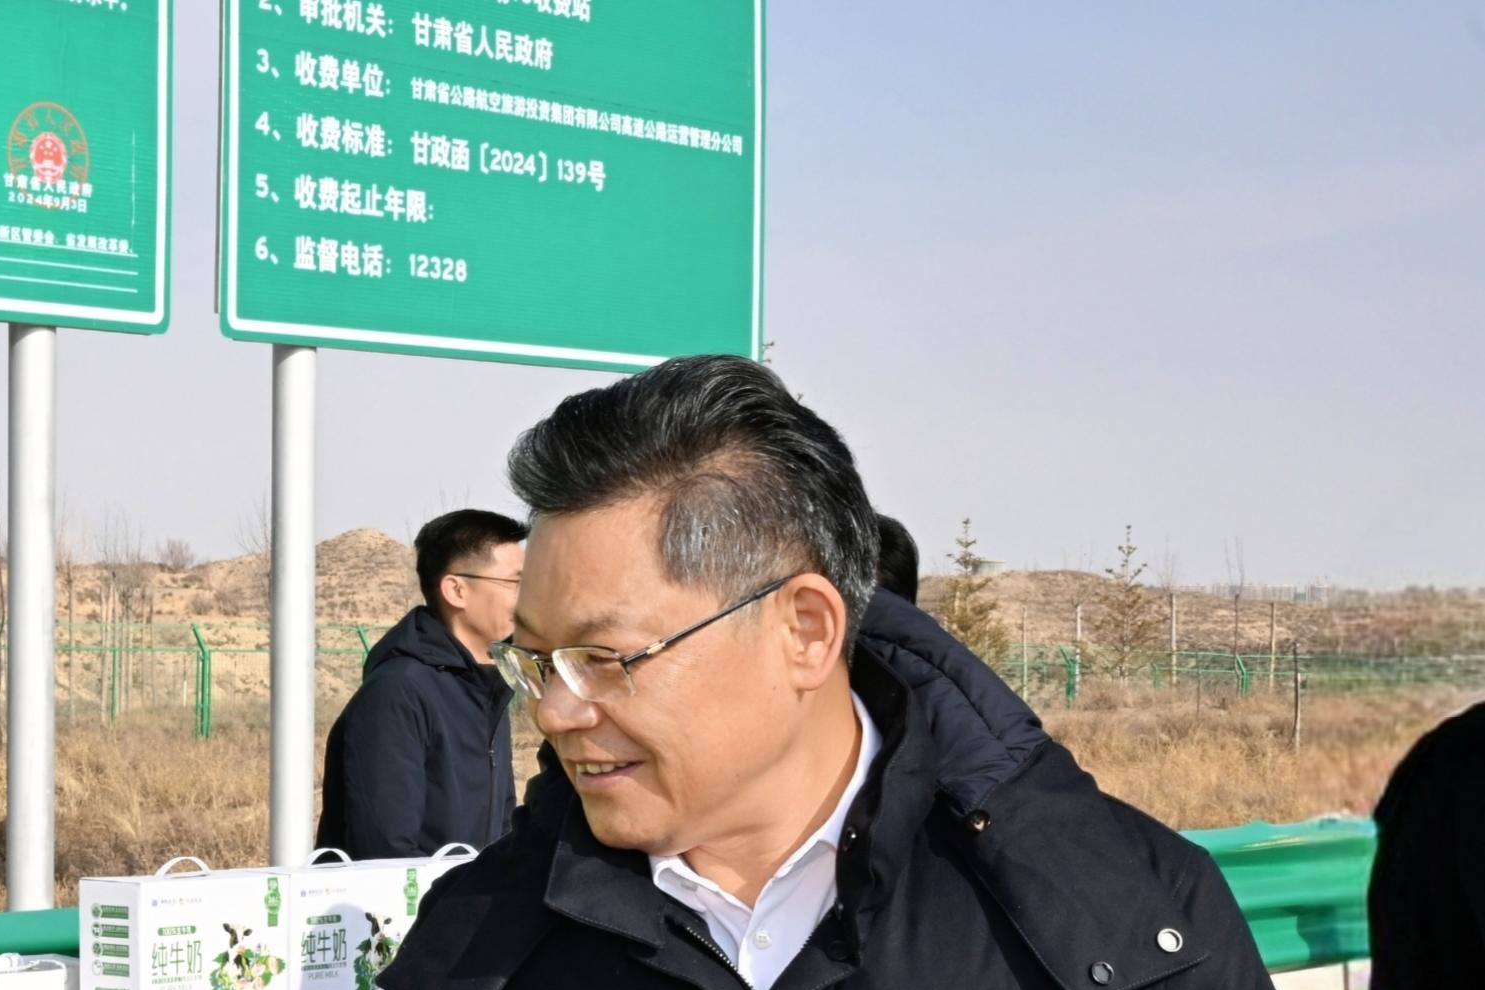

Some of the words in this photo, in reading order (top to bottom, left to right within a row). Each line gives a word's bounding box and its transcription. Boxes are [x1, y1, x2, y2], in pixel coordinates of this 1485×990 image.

[411, 12, 554, 70] 甘肃省人民政府
[3, 172, 93, 198] 甘肃省人民政府
[409, 254, 467, 282] 12328
[151, 940, 203, 976] 纯牛奶
[301, 928, 347, 963] 纯牛奶
